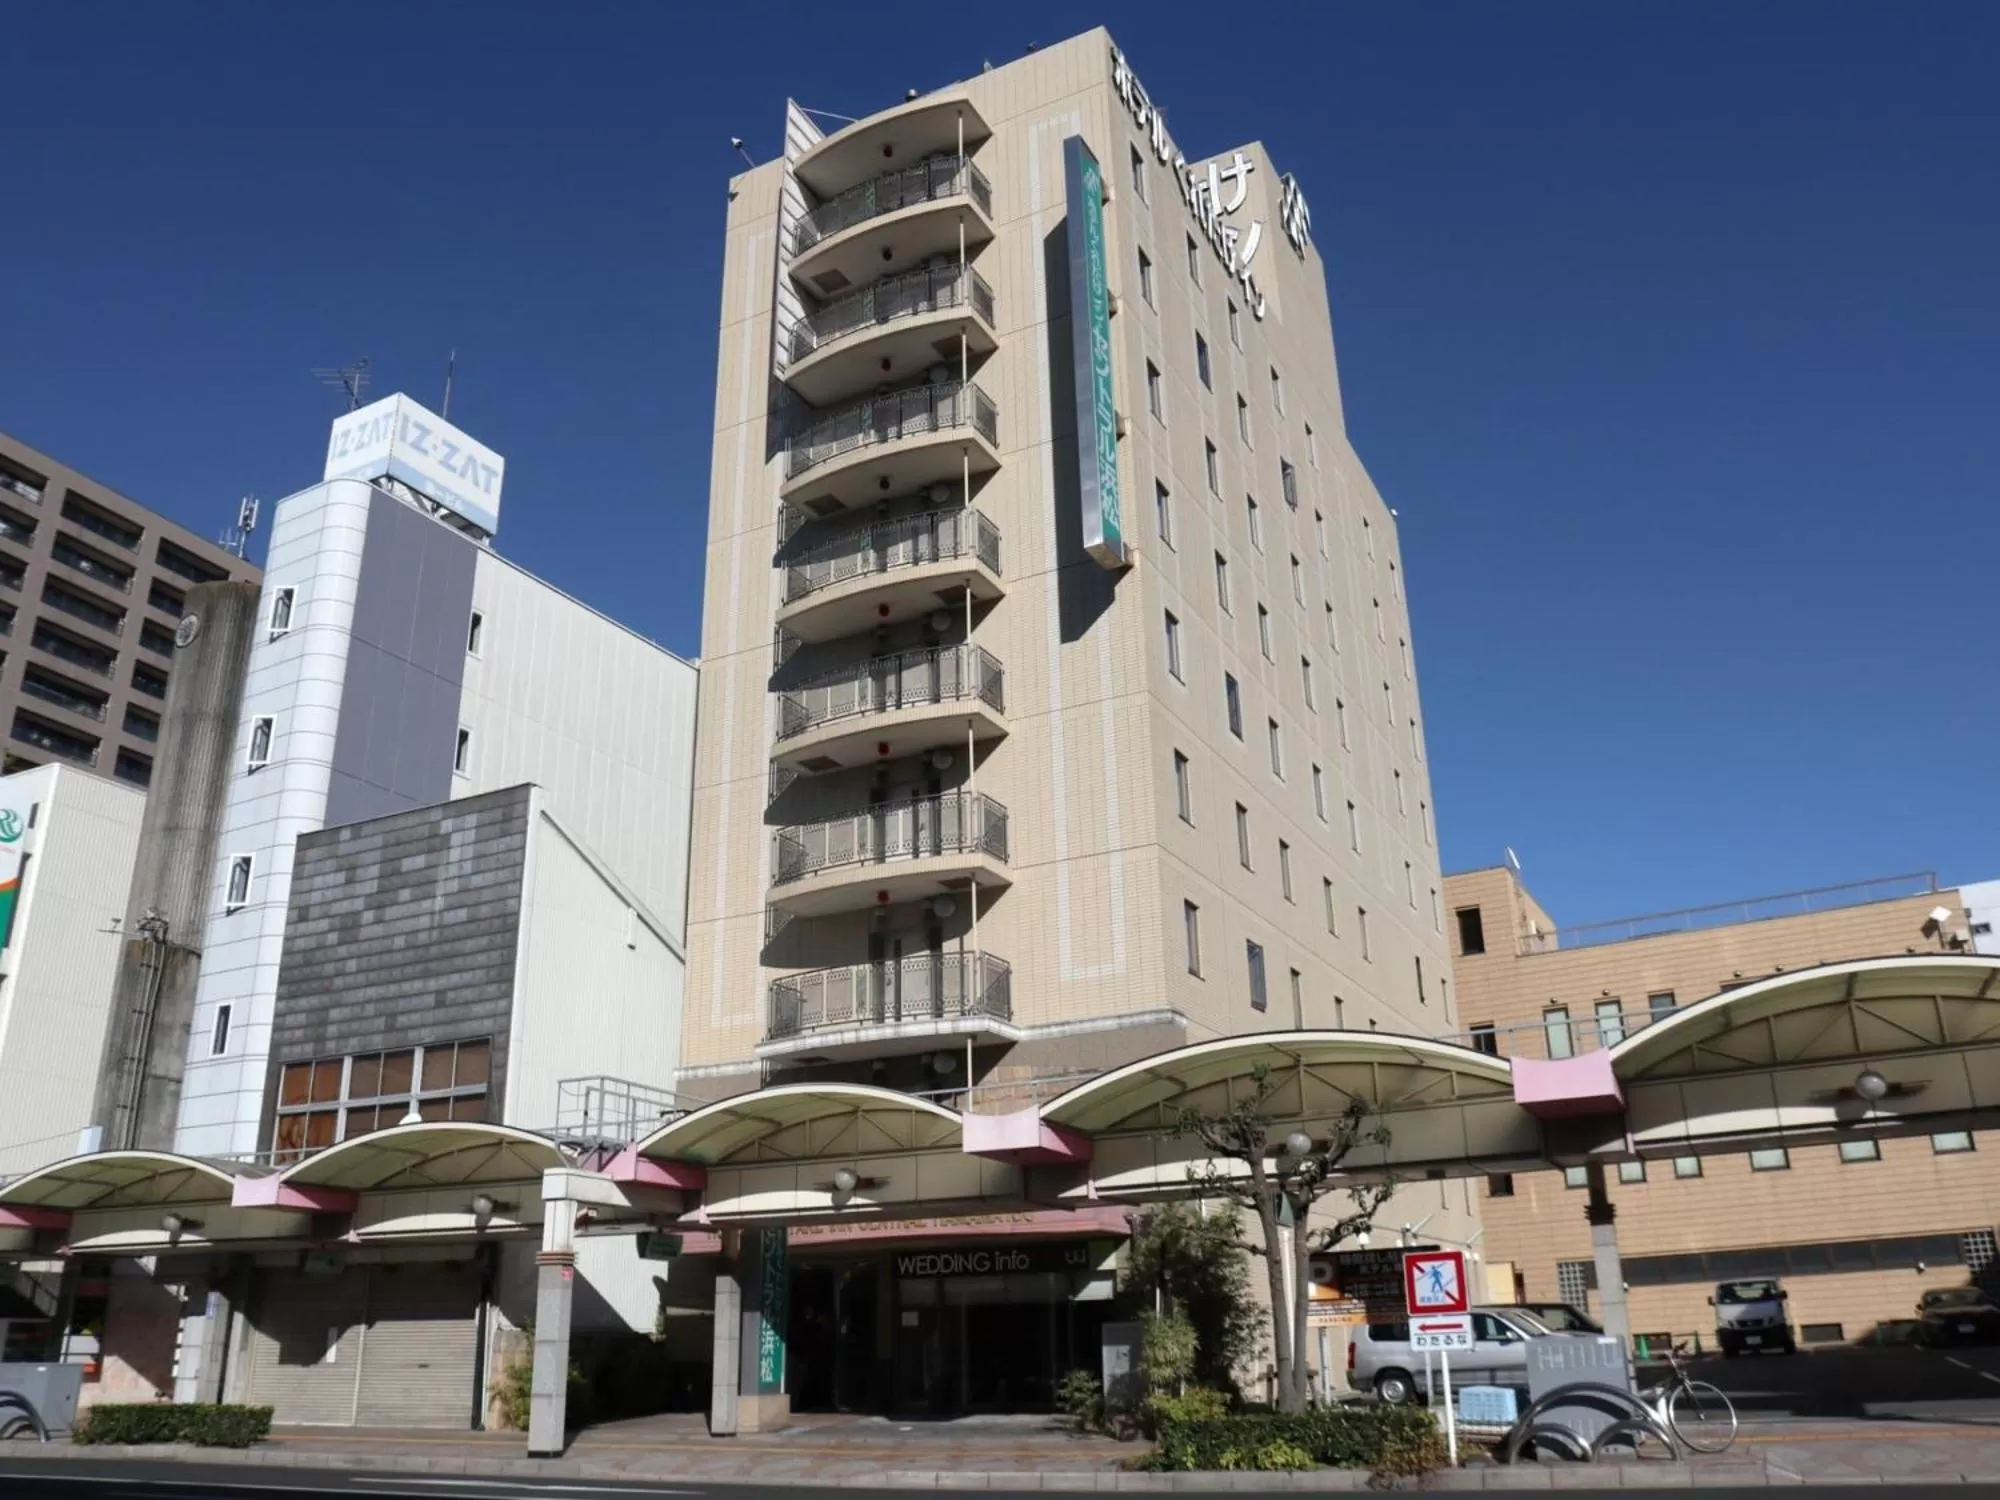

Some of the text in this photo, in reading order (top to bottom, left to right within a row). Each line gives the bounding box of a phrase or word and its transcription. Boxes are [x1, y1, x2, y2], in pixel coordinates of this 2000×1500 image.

[898, 1248, 1031, 1276] WEDDING info
[1416, 1334, 1467, 1347] わたるな
